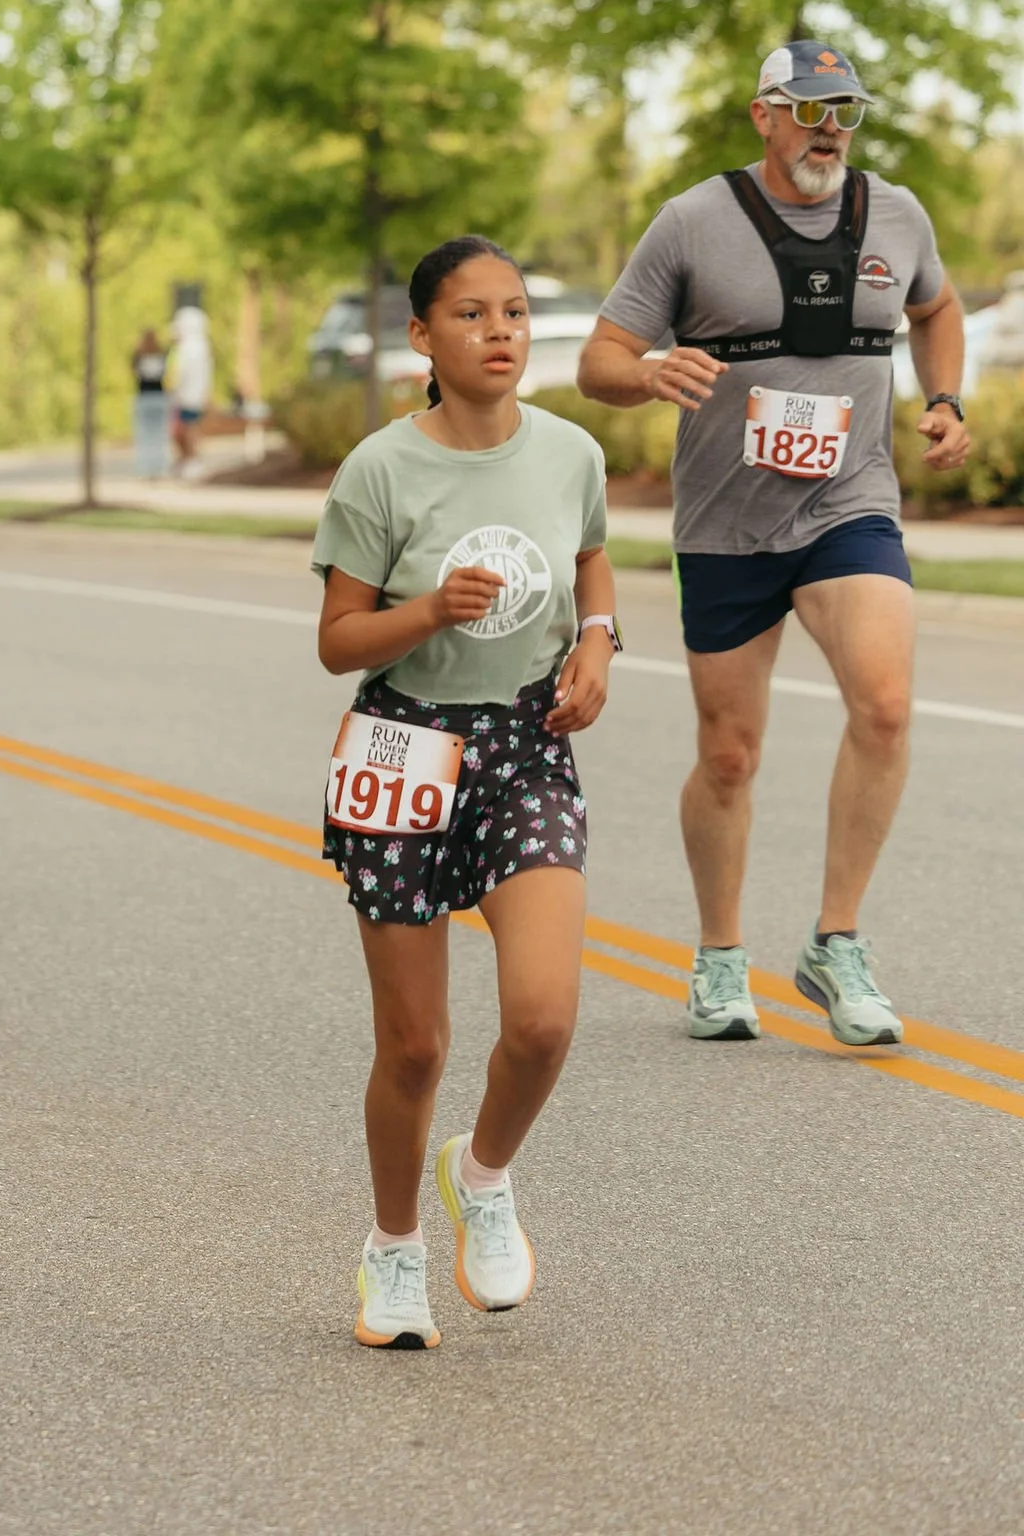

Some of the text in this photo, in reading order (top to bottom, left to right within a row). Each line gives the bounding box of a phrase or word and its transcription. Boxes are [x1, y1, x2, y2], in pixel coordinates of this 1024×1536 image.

[793, 296, 808, 305] ALL
[729, 344, 748, 353] ALL
[785, 398, 816, 411] RUN
[784, 415, 813, 426] LIVES
[752, 426, 838, 470] 1825
[372, 726, 411, 746] RUN
[380, 743, 407, 755] THEIR
[368, 749, 405, 767] LIVES
[335, 765, 443, 830] 1919
